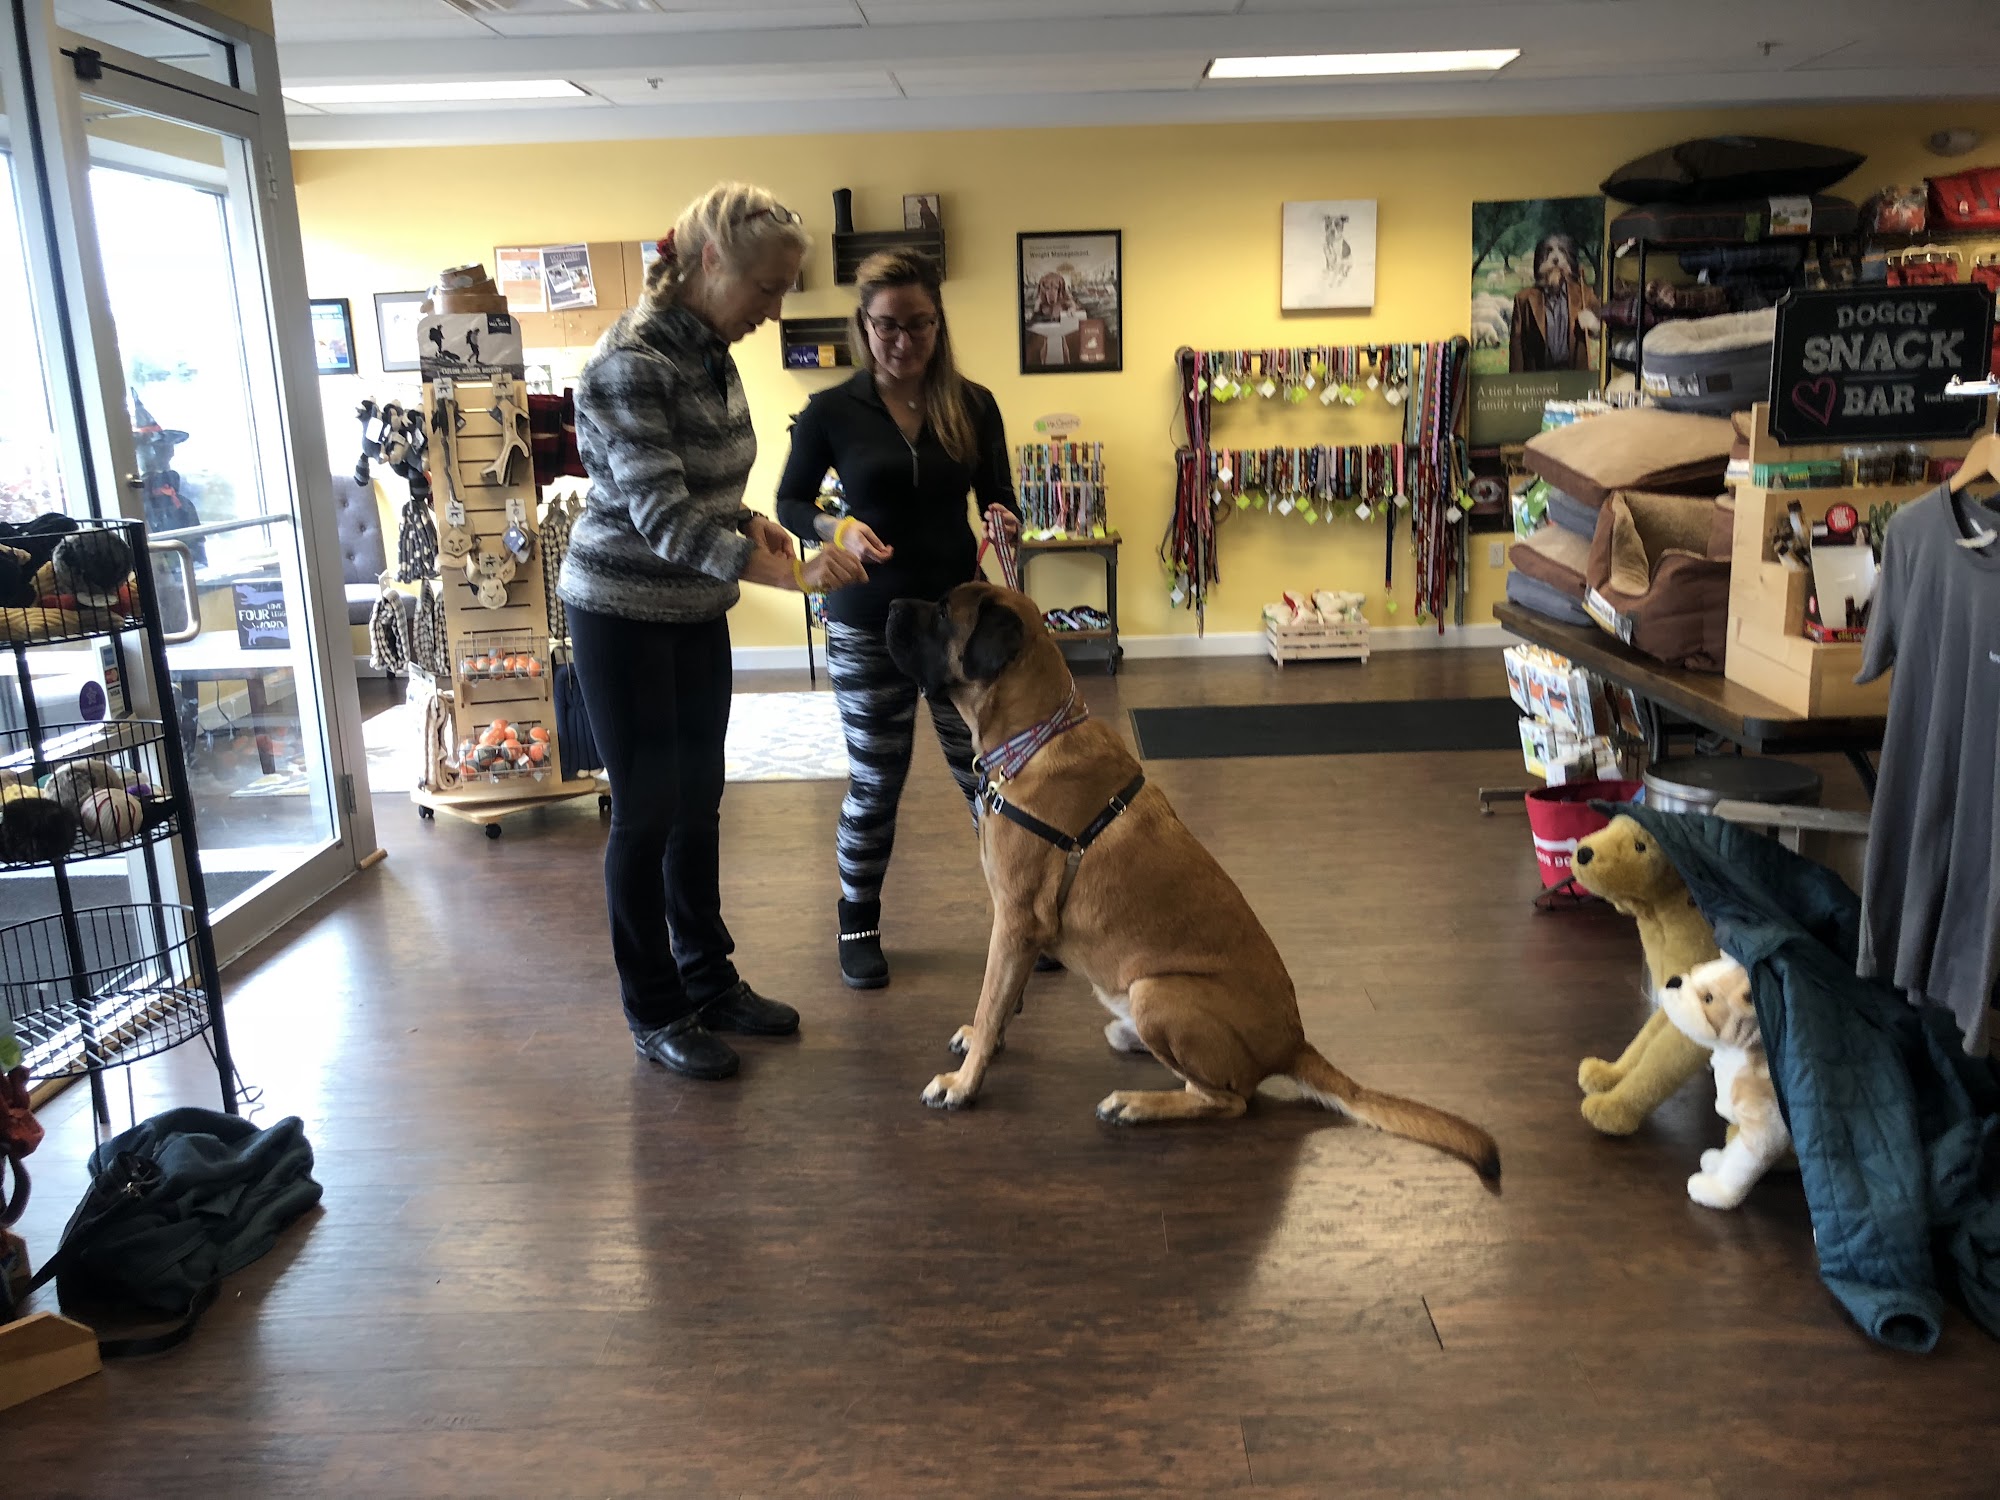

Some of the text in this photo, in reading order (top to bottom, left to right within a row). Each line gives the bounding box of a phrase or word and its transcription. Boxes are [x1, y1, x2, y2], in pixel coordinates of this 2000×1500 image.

[1029, 251, 1050, 259] Weight
[1837, 301, 1937, 328] DOGGY
[1802, 328, 1964, 374] SNACK
[1477, 382, 1559, 397] A time honored
[1477, 398, 1509, 412] family
[1841, 383, 1916, 416] BAR
[238, 608, 270, 621] FOUR
[251, 620, 285, 632] WORD
